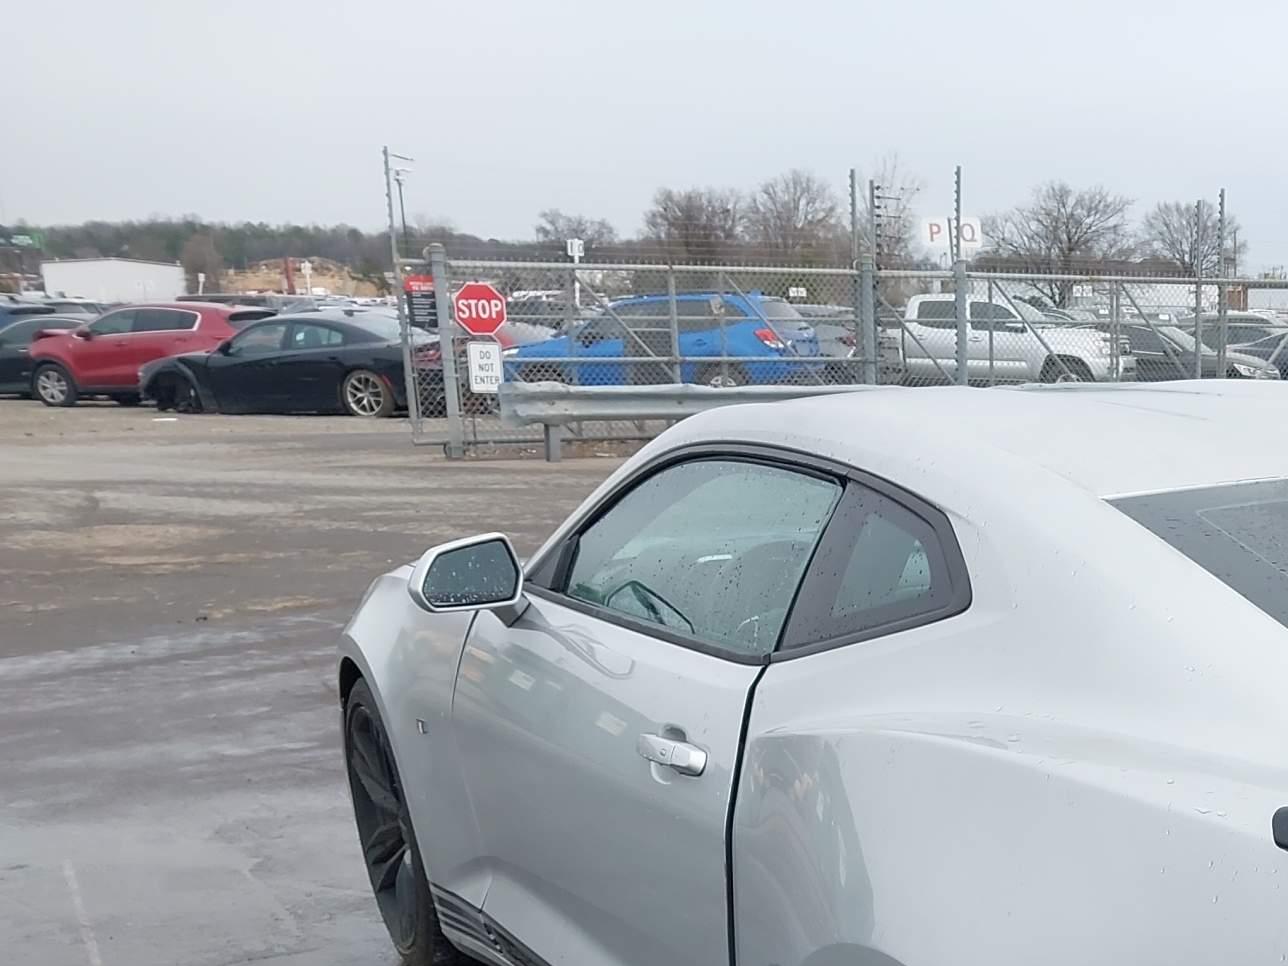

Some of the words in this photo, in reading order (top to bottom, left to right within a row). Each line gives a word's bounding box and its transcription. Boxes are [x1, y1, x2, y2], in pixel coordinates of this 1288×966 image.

[929, 224, 941, 242] P
[960, 224, 977, 242] Q
[458, 299, 501, 319] STOP
[479, 350, 491, 359] DO
[478, 363, 494, 373] NOT
[474, 375, 500, 385] ENTER
